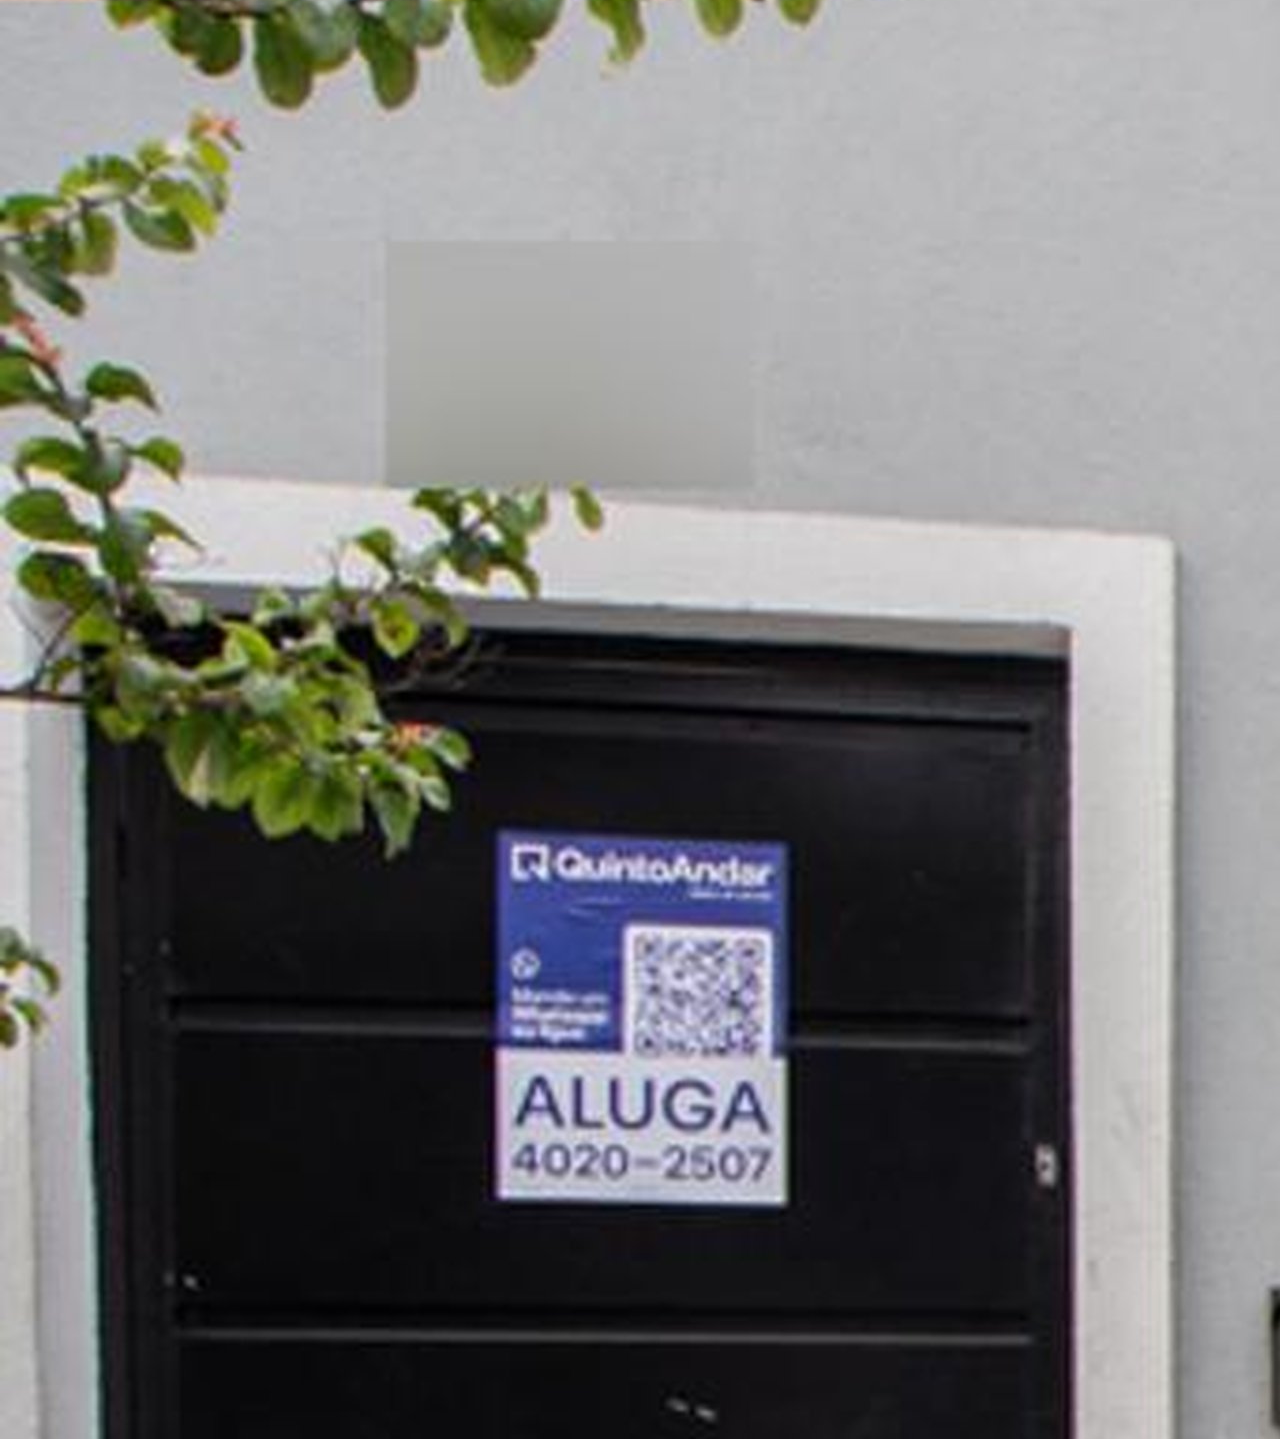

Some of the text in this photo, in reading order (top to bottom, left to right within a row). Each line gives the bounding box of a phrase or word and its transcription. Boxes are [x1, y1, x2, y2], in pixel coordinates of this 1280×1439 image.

[555, 847, 774, 887] QuintoAndar
[515, 1075, 770, 1133] ALUGA
[513, 1144, 772, 1181] 4020-2507
